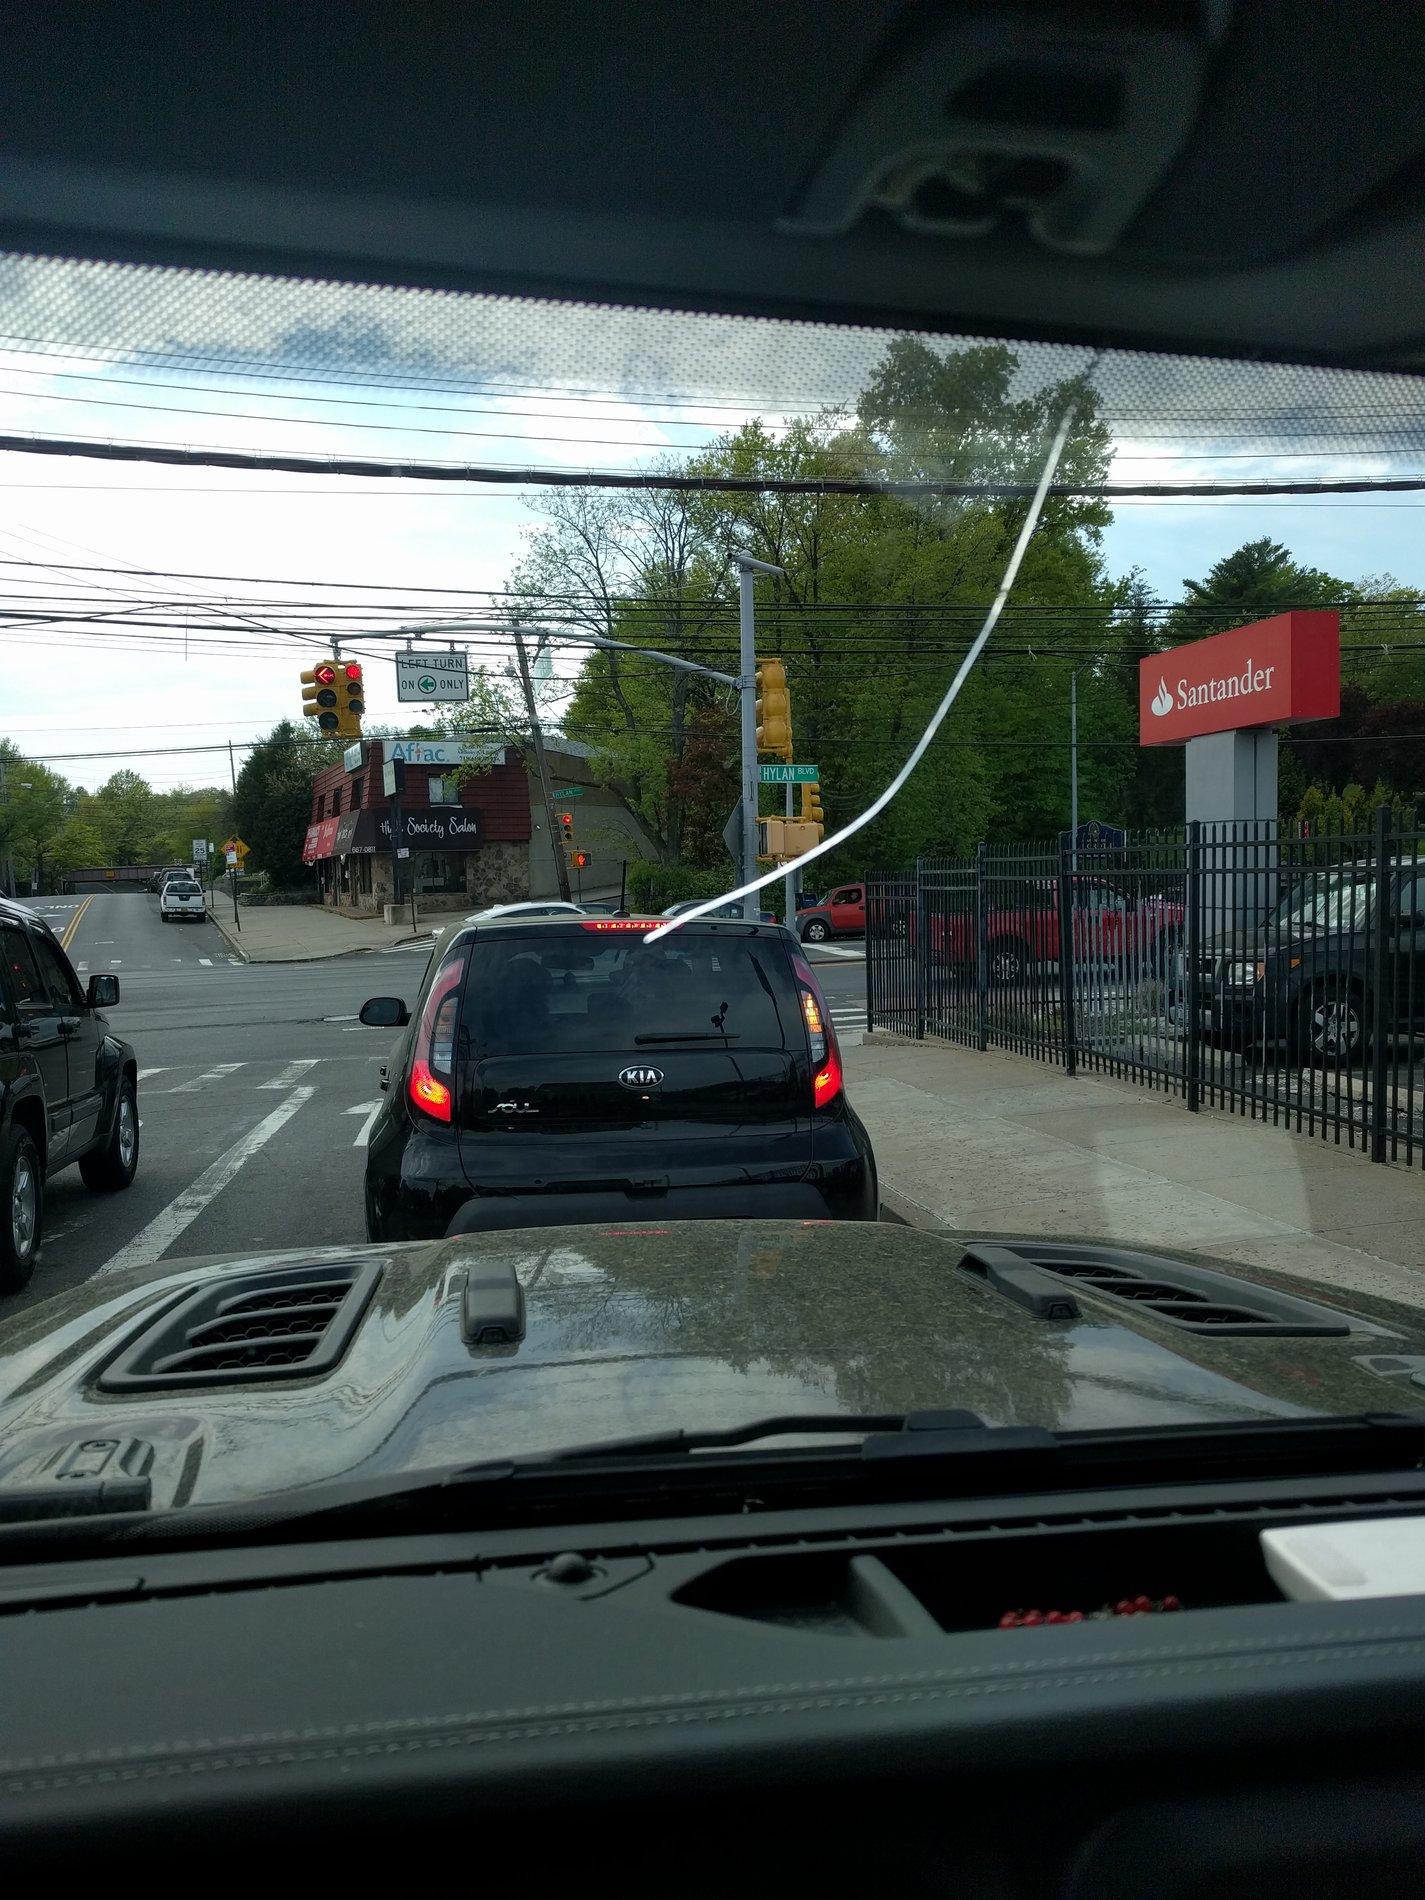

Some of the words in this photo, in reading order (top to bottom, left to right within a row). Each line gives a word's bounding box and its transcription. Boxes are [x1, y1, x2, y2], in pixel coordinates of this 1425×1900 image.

[401, 659, 430, 669] LEFT
[432, 659, 463, 669] TURN
[401, 679, 415, 690] ON
[440, 679, 464, 690] ONLY
[1177, 658, 1275, 710] Santander
[763, 767, 795, 780] HYLAN
[797, 767, 815, 775] BLVD
[407, 816, 445, 839] Society
[448, 816, 477, 835] Salon
[626, 1070, 658, 1084] KIA
